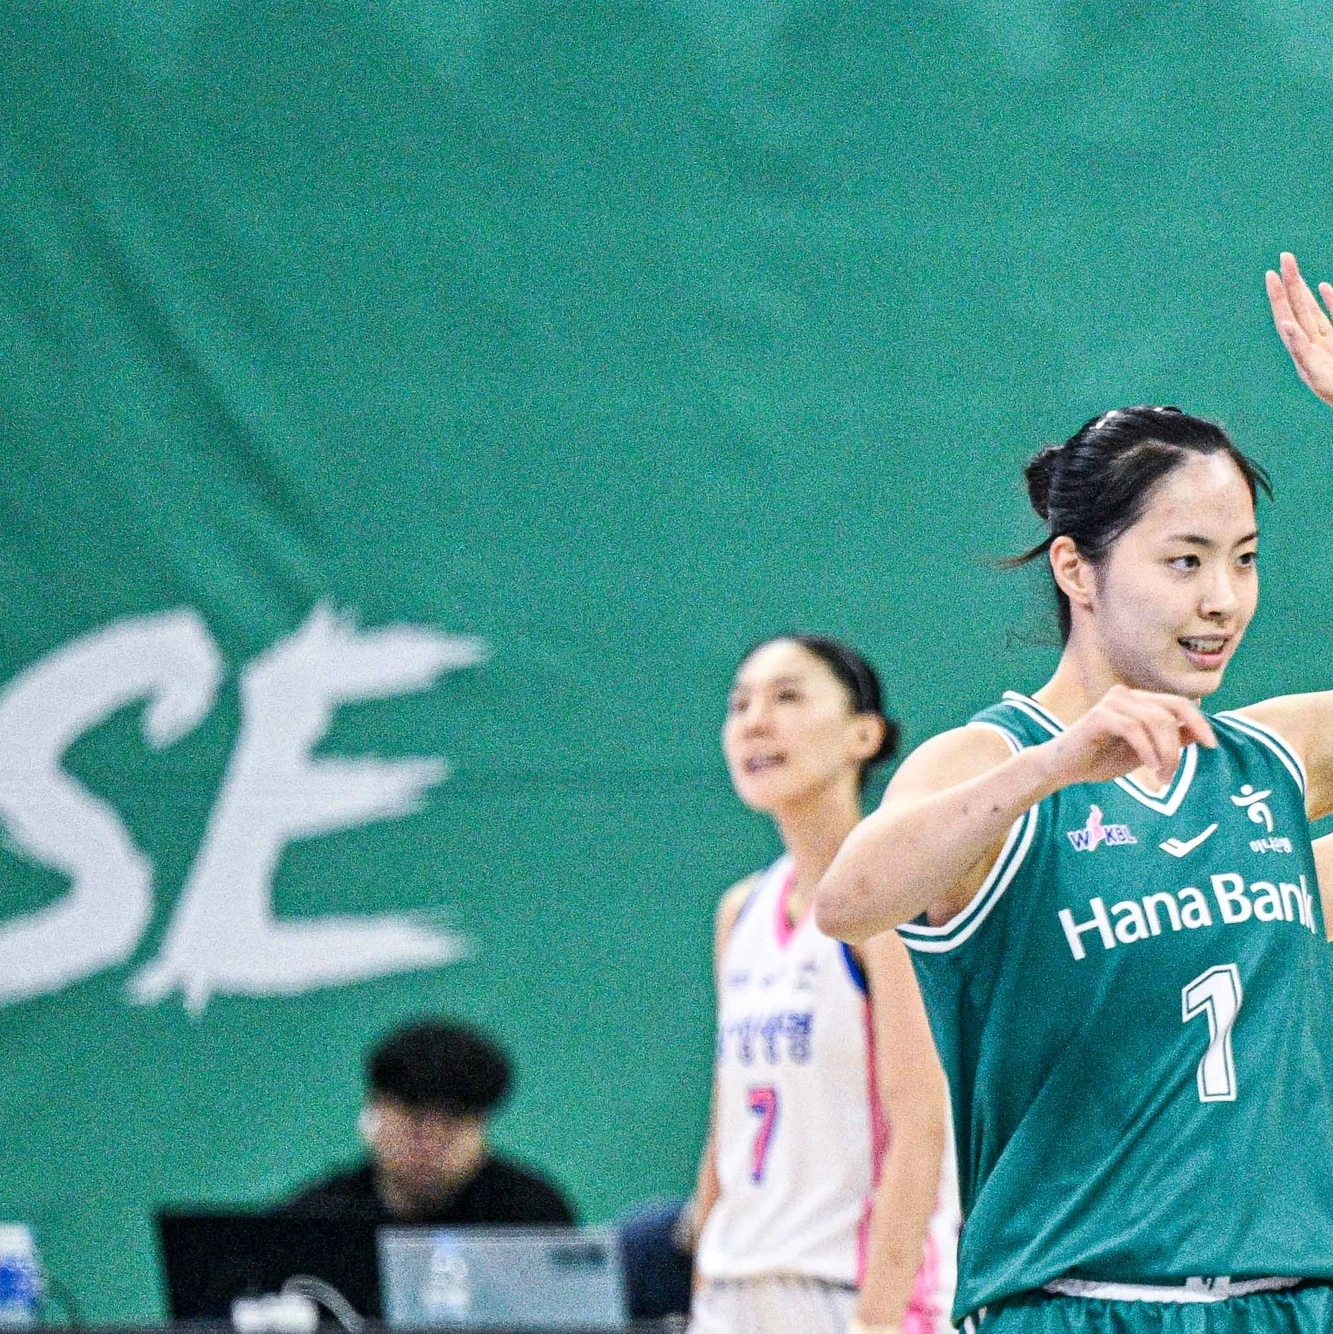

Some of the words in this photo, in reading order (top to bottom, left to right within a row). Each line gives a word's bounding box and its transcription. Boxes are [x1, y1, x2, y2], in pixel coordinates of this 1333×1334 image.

[1058, 886, 1212, 960] Hana
[1210, 871, 1317, 935] Bank
[1182, 963, 1243, 1102] 1
[747, 1085, 779, 1186] 7
